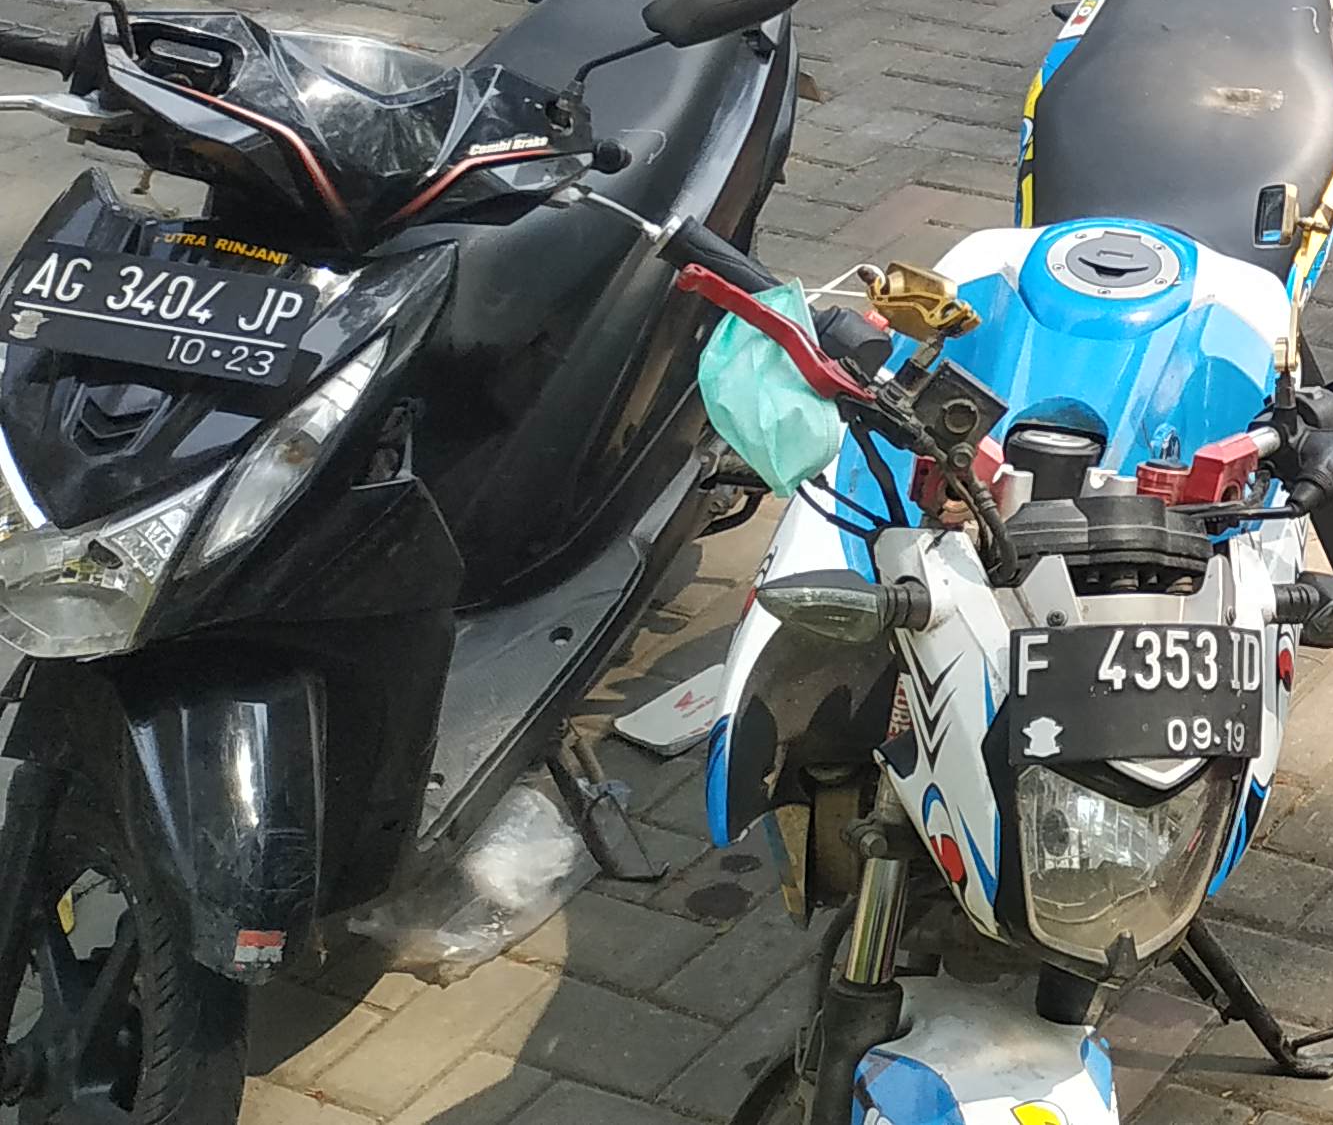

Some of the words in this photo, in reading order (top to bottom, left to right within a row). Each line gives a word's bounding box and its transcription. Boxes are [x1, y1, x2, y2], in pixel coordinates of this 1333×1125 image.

[468, 139, 512, 156] Combi
[512, 136, 549, 150] Brake
[214, 237, 289, 266] RINJANI
[22, 252, 93, 303] AG
[105, 265, 229, 325] 3404
[237, 287, 304, 336] JP
[1017, 633, 1050, 696] F
[1097, 629, 1219, 691] 4353
